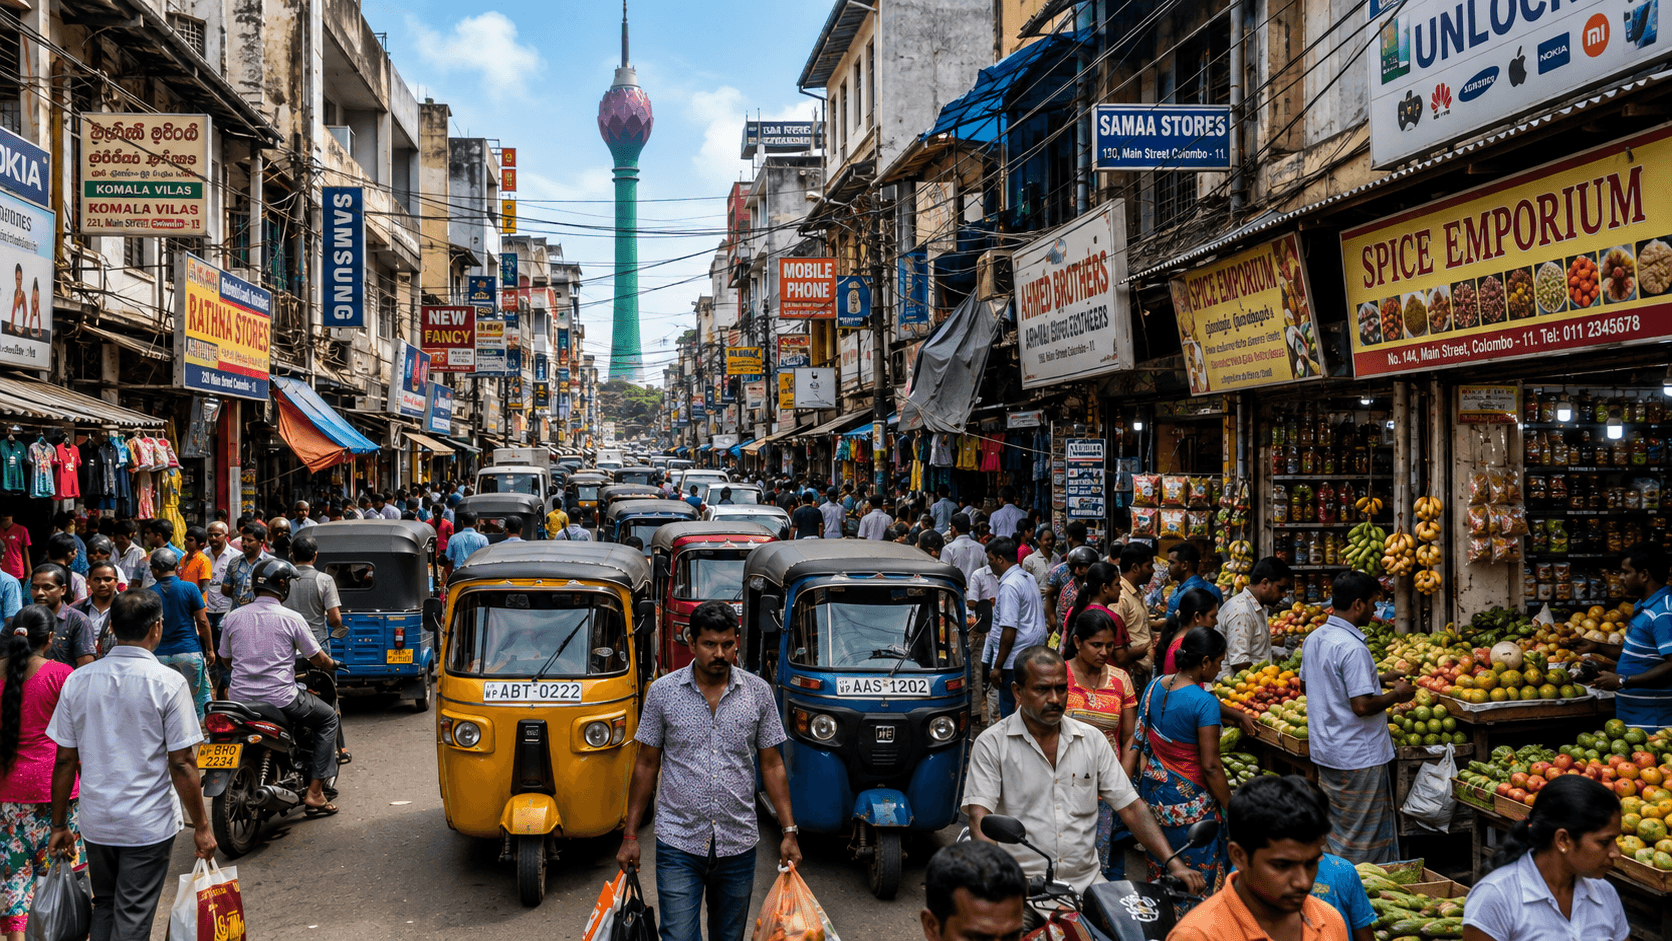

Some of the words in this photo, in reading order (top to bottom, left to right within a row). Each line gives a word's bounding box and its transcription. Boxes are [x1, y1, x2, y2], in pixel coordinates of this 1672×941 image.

[1415, 0, 1577, 69] UNLO
[1540, 44, 1568, 62] NOKIA
[1100, 115, 1157, 136] SAMAA
[1161, 115, 1226, 136] STORES
[1122, 147, 1142, 158] Main
[96, 185, 150, 194] KOMALA
[155, 185, 192, 195] VILAS
[88, 203, 151, 214] KOMALA
[155, 204, 198, 215] VILAS
[1361, 227, 1434, 289] SPICE
[1443, 164, 1646, 270] EMPORIUM
[333, 193, 353, 320] SAMSUNG
[783, 262, 832, 279] MOBILE
[787, 282, 830, 298] PHONE
[1021, 274, 1052, 321] AHMED
[1053, 250, 1109, 310] BROTHERS
[1188, 273, 1219, 311] SPICE
[1216, 252, 1277, 303] EMPORIUM
[188, 293, 232, 341] RATHNA
[235, 313, 269, 352] STORES
[428, 310, 467, 325] NEW
[424, 330, 471, 344] FANCY
[1387, 352, 1401, 366] No.
[1402, 349, 1419, 363] 144,
[1420, 345, 1441, 361] Main
[1441, 341, 1471, 358] Street,
[1472, 335, 1514, 354] Colombo
[1522, 331, 1538, 347] 11.
[1540, 327, 1560, 344] Tel:
[1563, 323, 1583, 341] 011
[1587, 314, 1641, 338] 2345678
[853, 679, 882, 693] AAS
[889, 679, 927, 693] 1202
[205, 756, 234, 767] 2234
